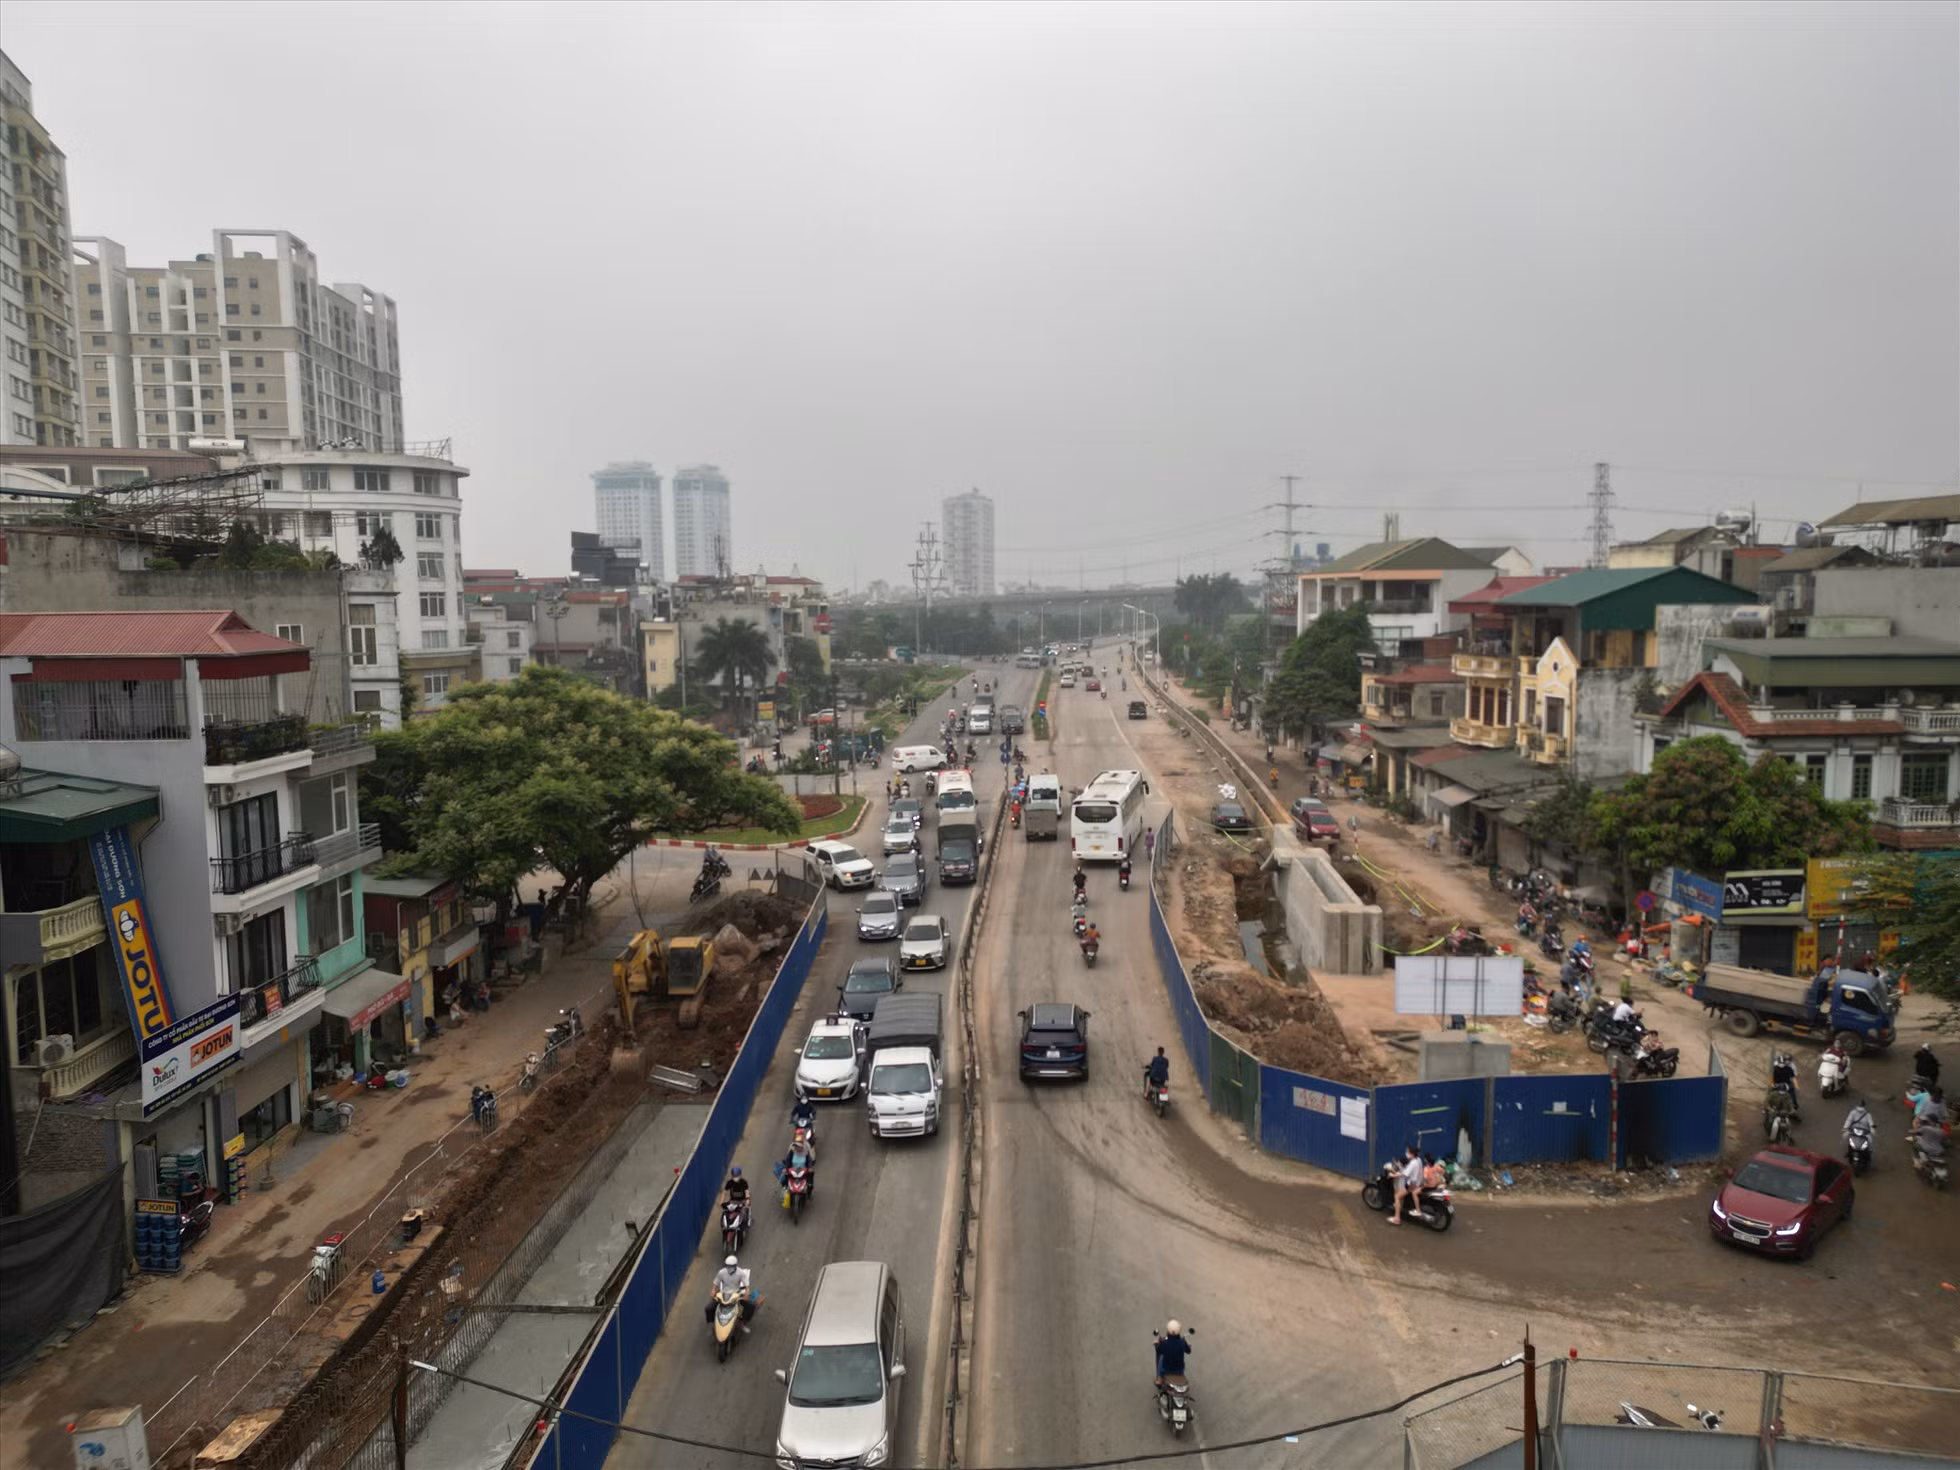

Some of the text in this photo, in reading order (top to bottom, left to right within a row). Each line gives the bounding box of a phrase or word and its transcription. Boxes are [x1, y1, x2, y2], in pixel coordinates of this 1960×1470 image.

[126, 947, 165, 1035] JOTU
[201, 1030, 232, 1059] JOTUN
[152, 1068, 176, 1086] Dulux
[148, 1204, 175, 1212] JOTUN
